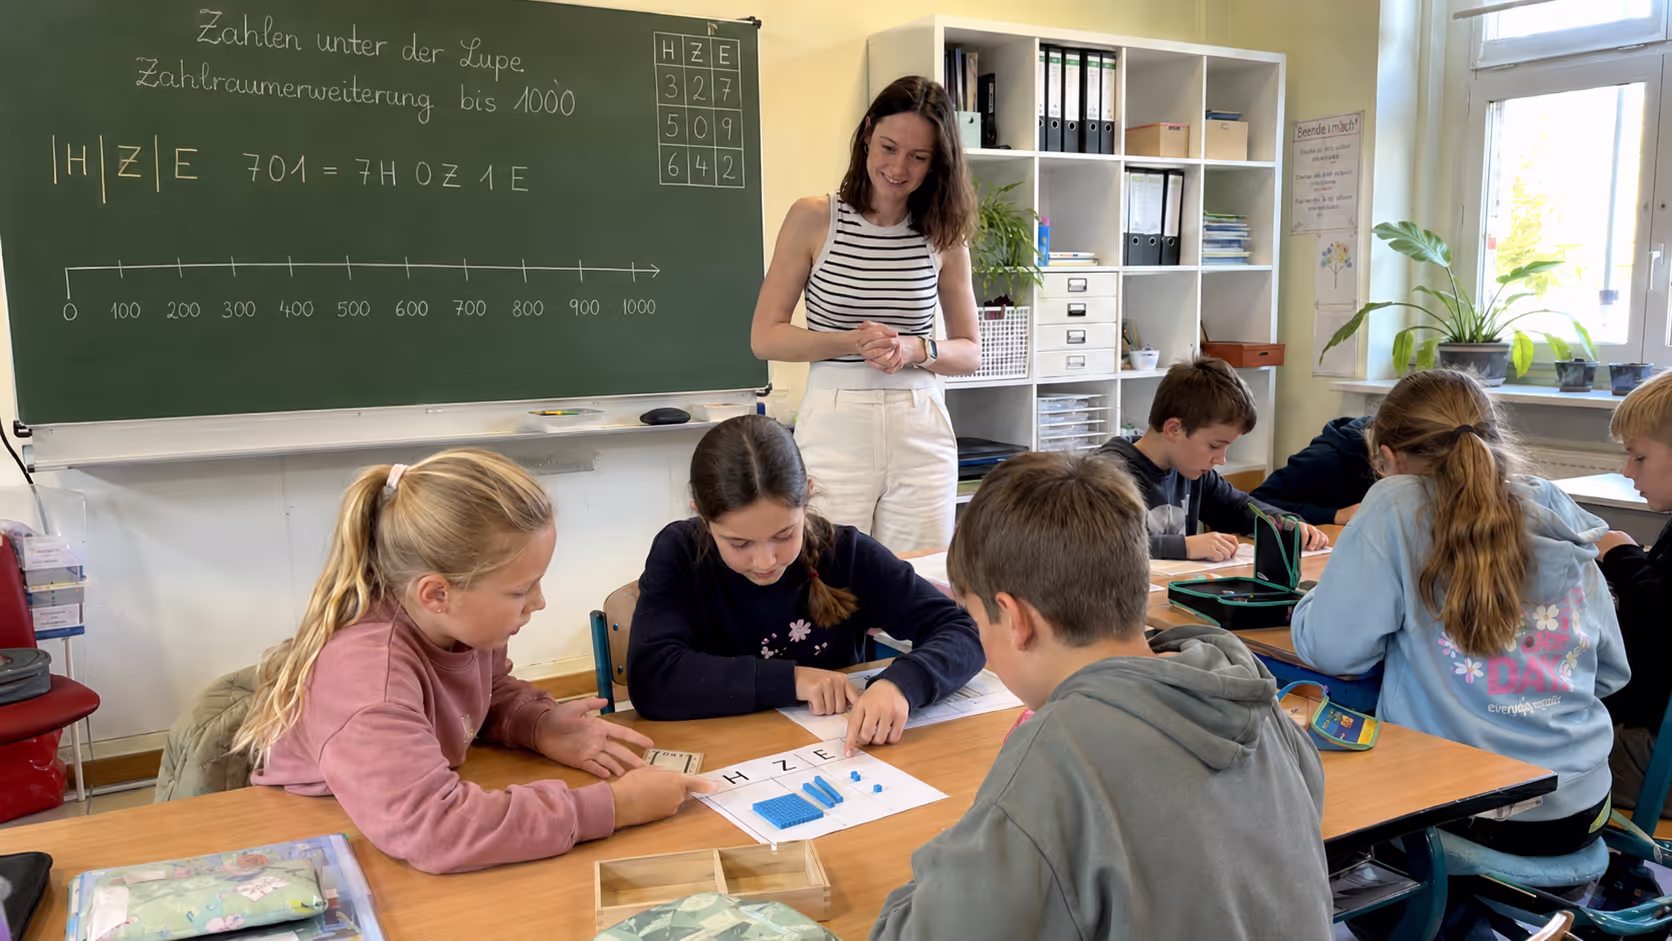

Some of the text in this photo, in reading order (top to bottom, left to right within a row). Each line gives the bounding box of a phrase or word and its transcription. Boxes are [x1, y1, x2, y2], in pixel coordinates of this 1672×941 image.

[196, 8, 303, 51] Zahlen
[316, 23, 388, 57] unter
[402, 32, 445, 64] der
[662, 39, 731, 65] H Z E
[135, 56, 576, 125] Zahlraumerweiterung bis 1000
[665, 74, 732, 102] 3 2 7
[665, 113, 732, 141] 5 0 9
[174, 147, 199, 180] E
[242, 152, 306, 184] 701
[322, 166, 338, 175] =
[441, 163, 461, 188] Z
[479, 164, 493, 191] 1
[511, 165, 529, 192] E
[667, 152, 736, 180] 6 4 2
[62, 298, 656, 322] 0 100 200 300 400 500 600 700 800 900 1000
[722, 748, 836, 785] H Z E
